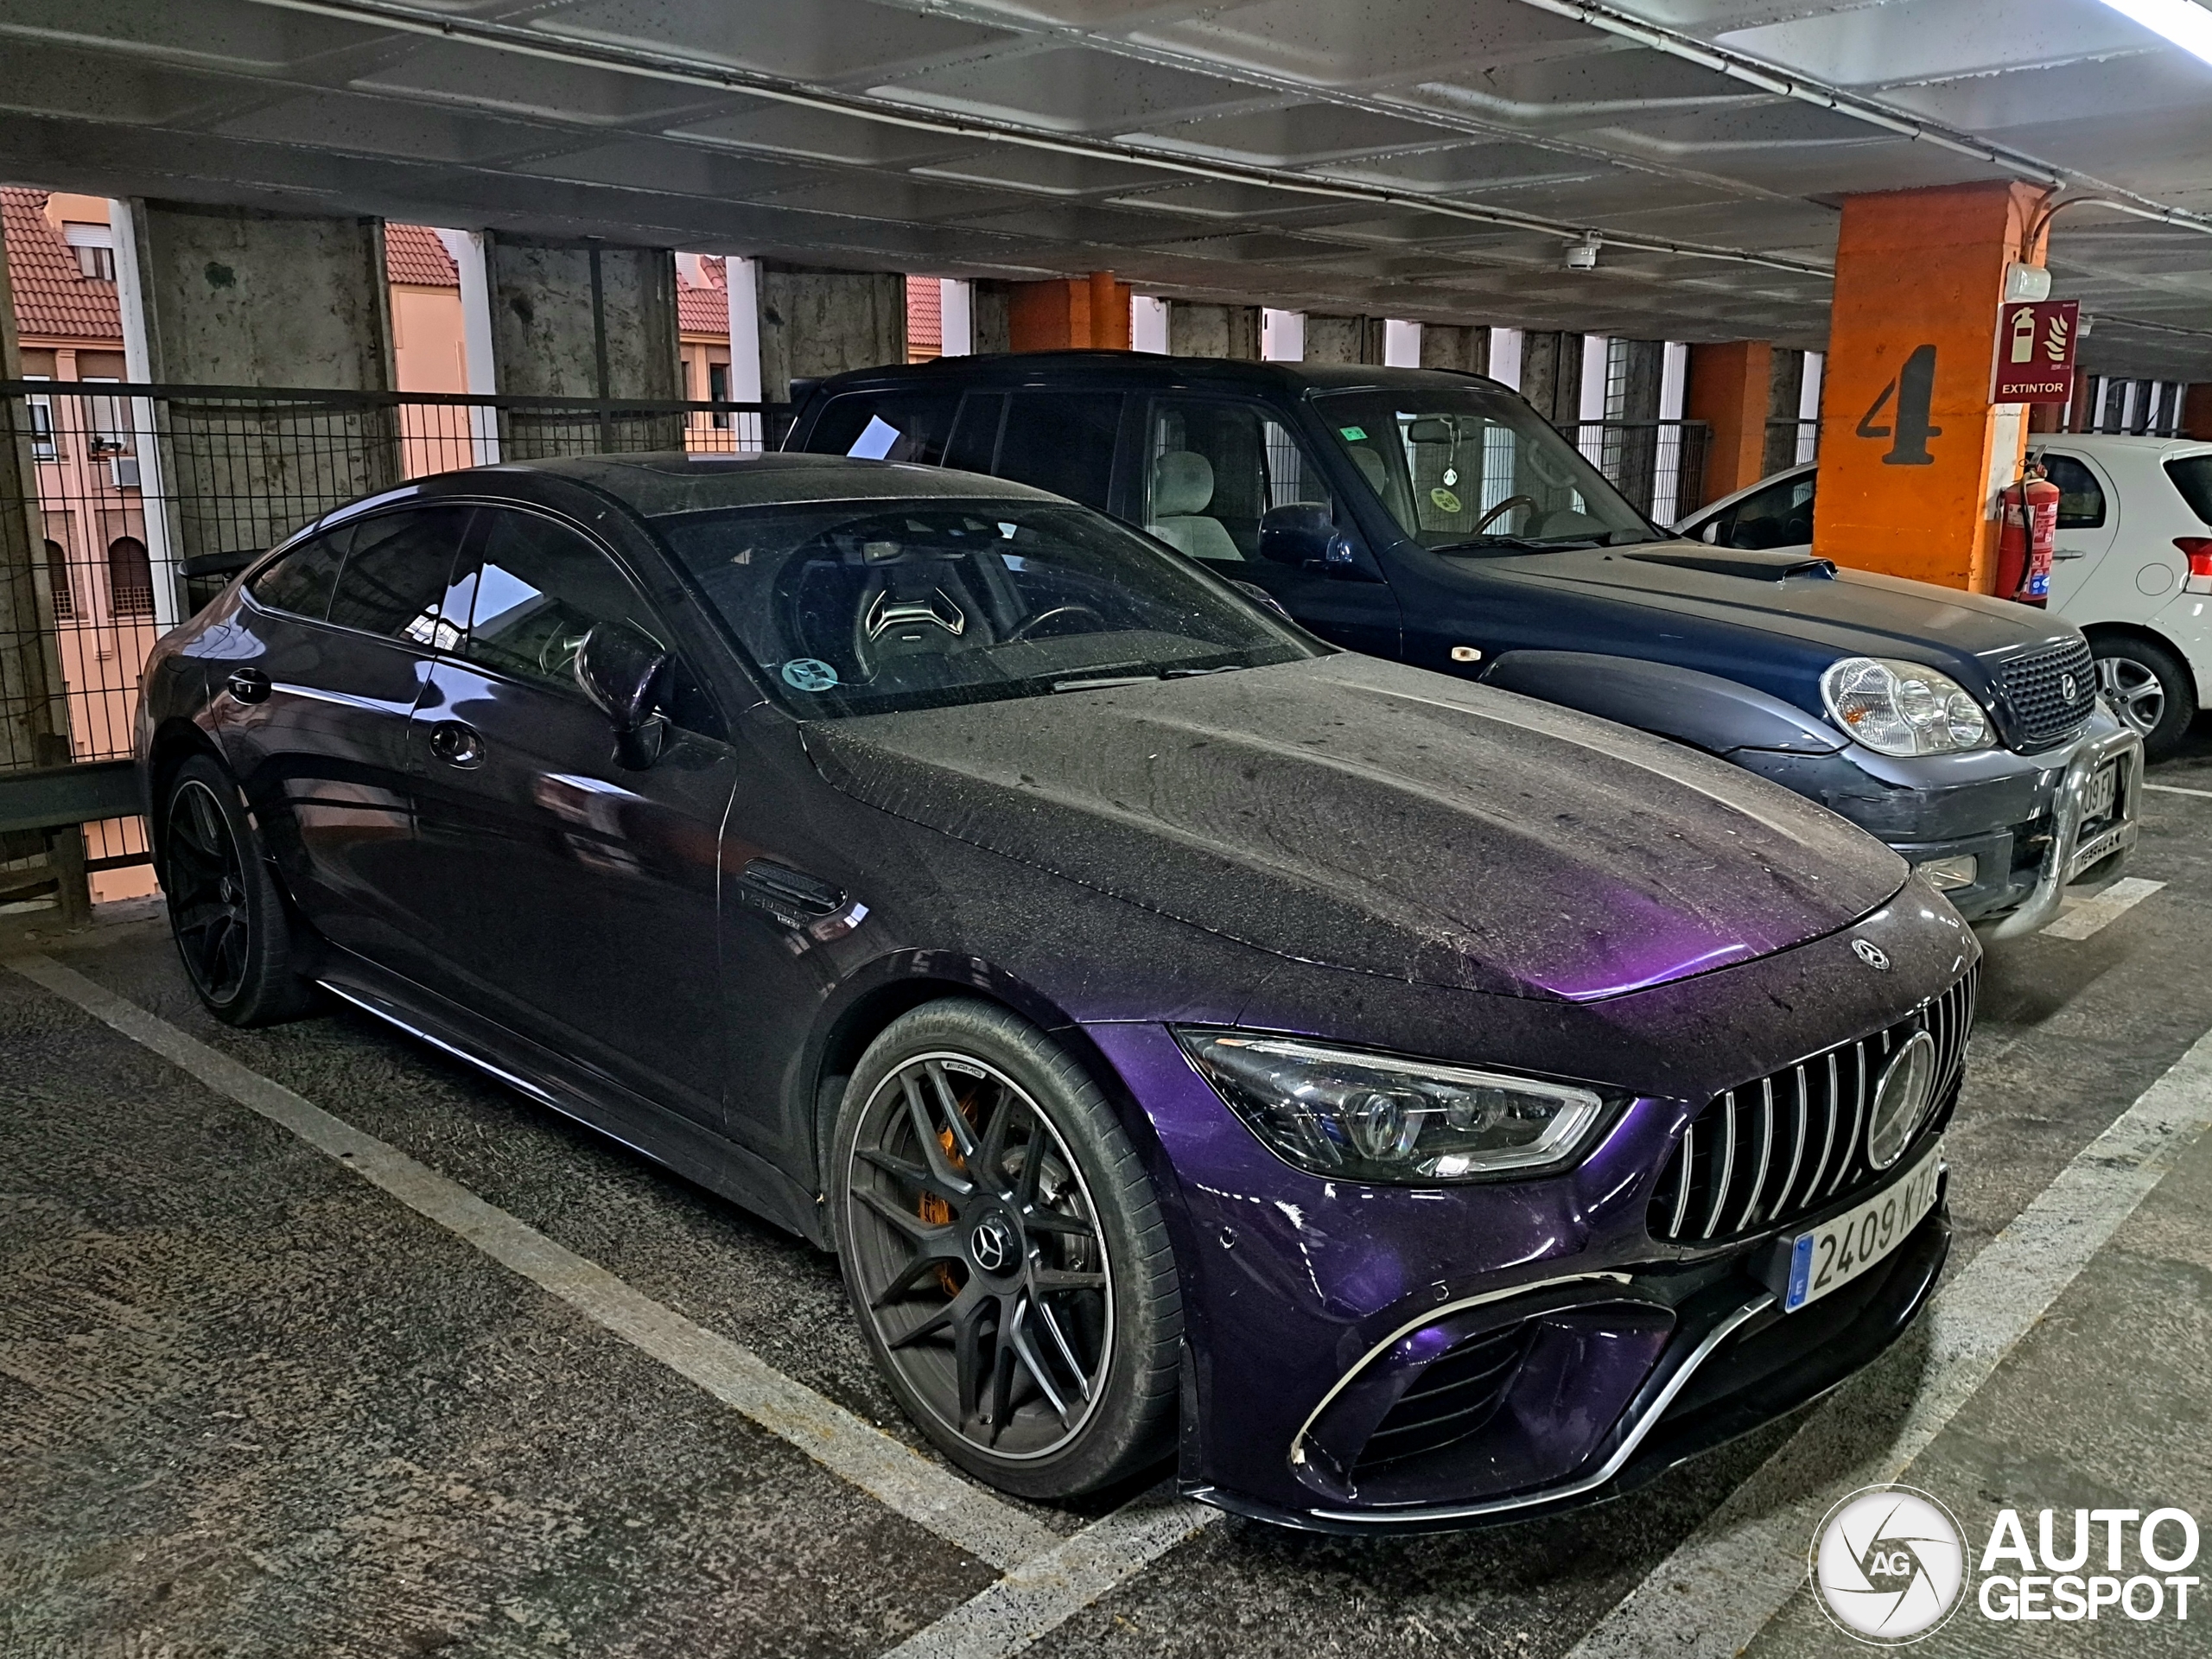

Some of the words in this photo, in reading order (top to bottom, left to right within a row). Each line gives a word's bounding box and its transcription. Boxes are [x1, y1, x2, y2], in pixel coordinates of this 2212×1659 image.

[1855, 344, 1942, 465] 4
[2002, 382, 2064, 394] EXTINTOR
[1795, 1278, 1804, 1296] E
[1814, 1198, 1897, 1291] 2409
